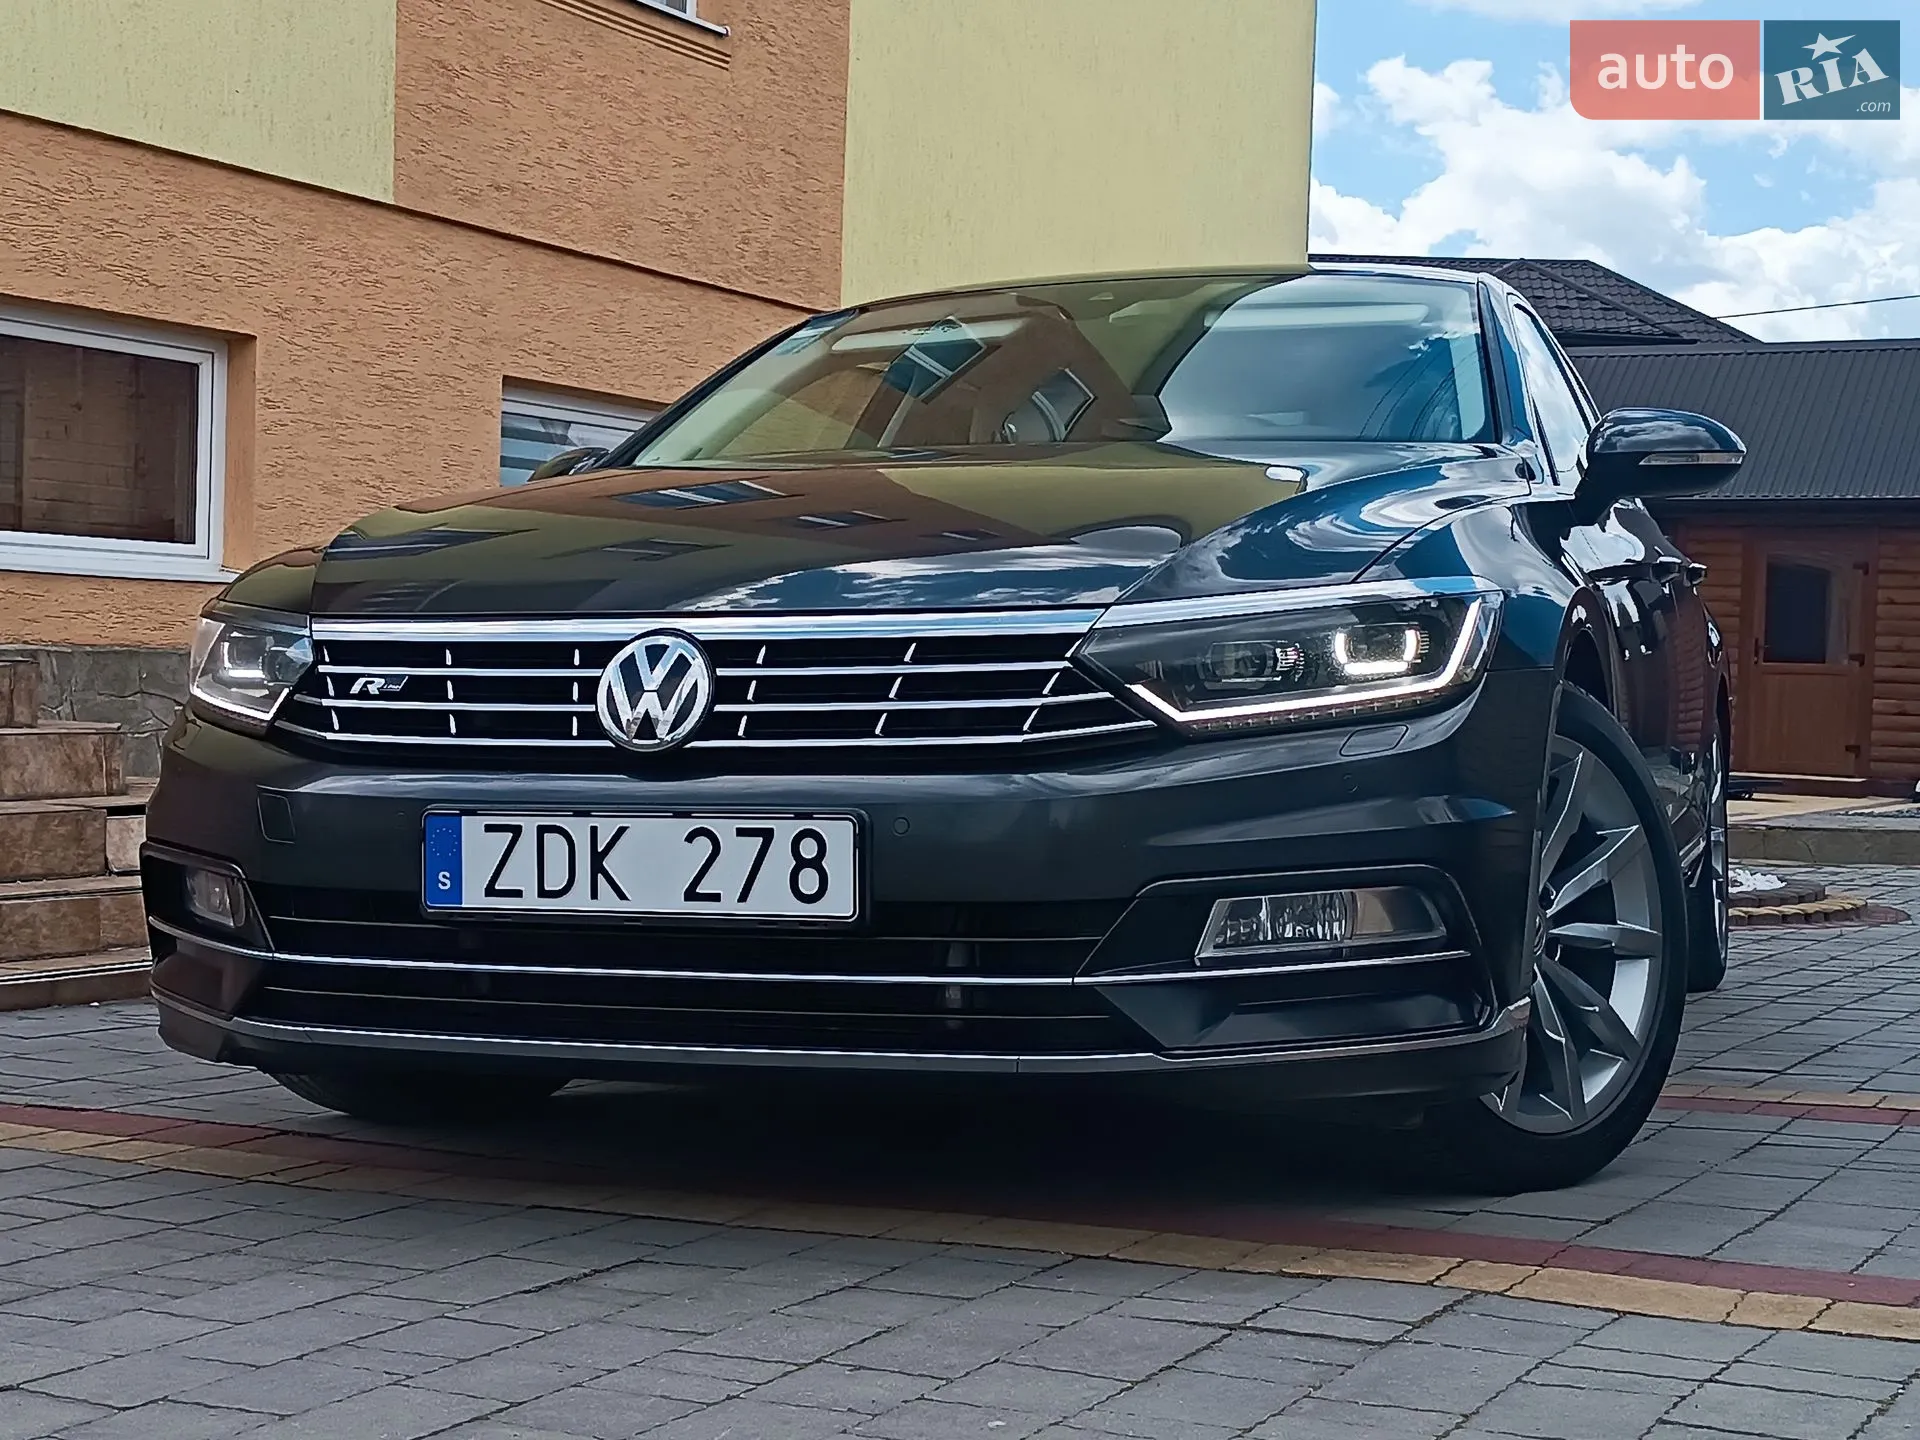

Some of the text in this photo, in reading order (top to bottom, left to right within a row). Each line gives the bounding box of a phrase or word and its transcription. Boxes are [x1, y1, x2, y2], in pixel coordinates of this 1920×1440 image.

[438, 871, 451, 890] S
[483, 823, 830, 905] ZDK 278
